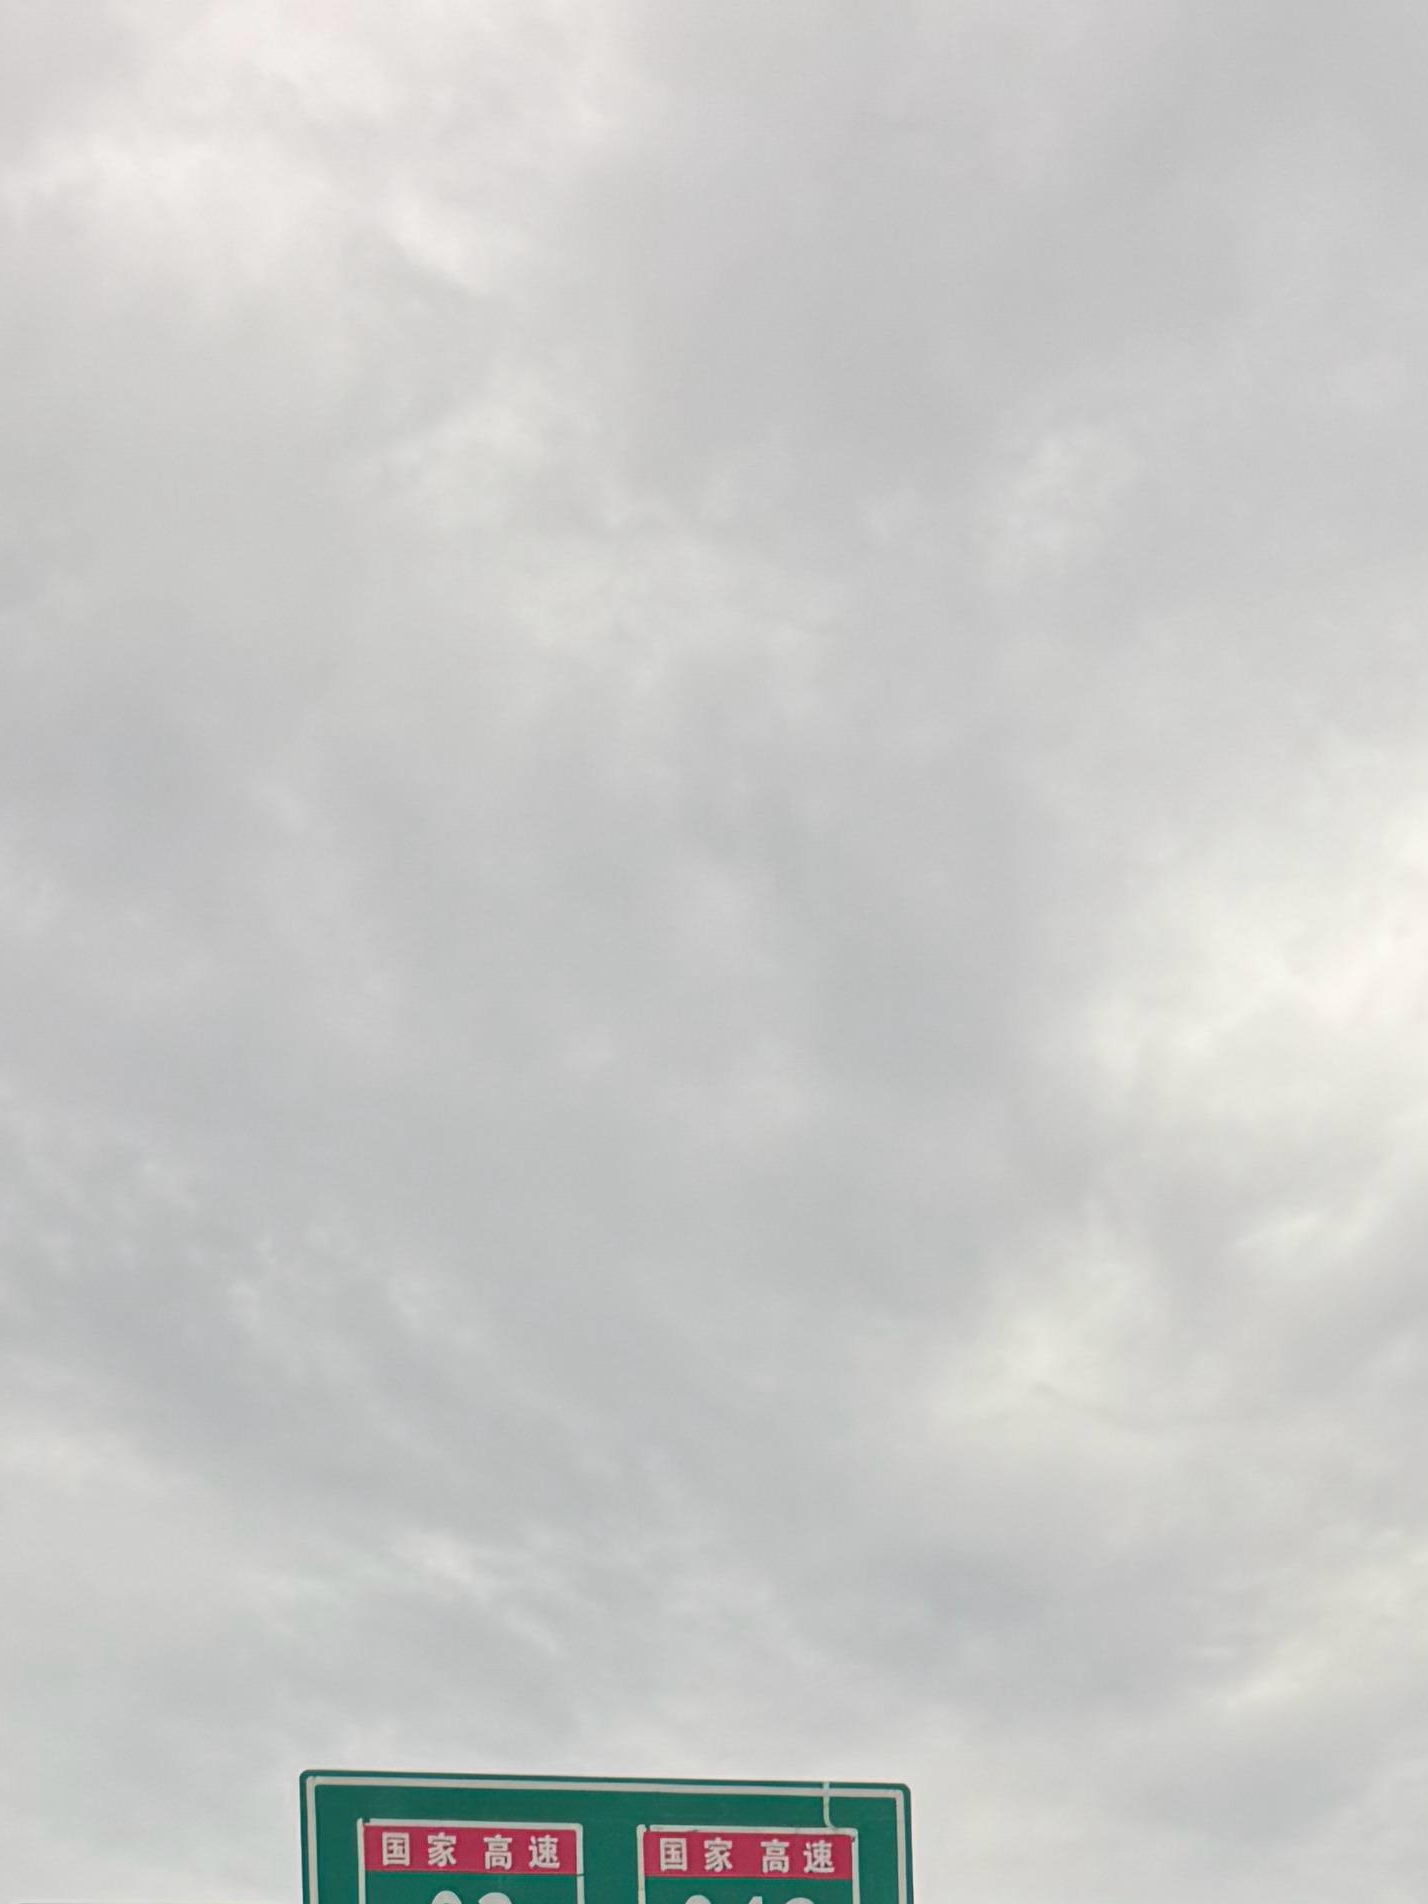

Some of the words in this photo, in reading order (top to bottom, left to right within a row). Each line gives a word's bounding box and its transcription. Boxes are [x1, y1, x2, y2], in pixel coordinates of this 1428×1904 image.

[381, 1832, 561, 1869] 国家高速
[659, 1838, 836, 1874] 国家高速
